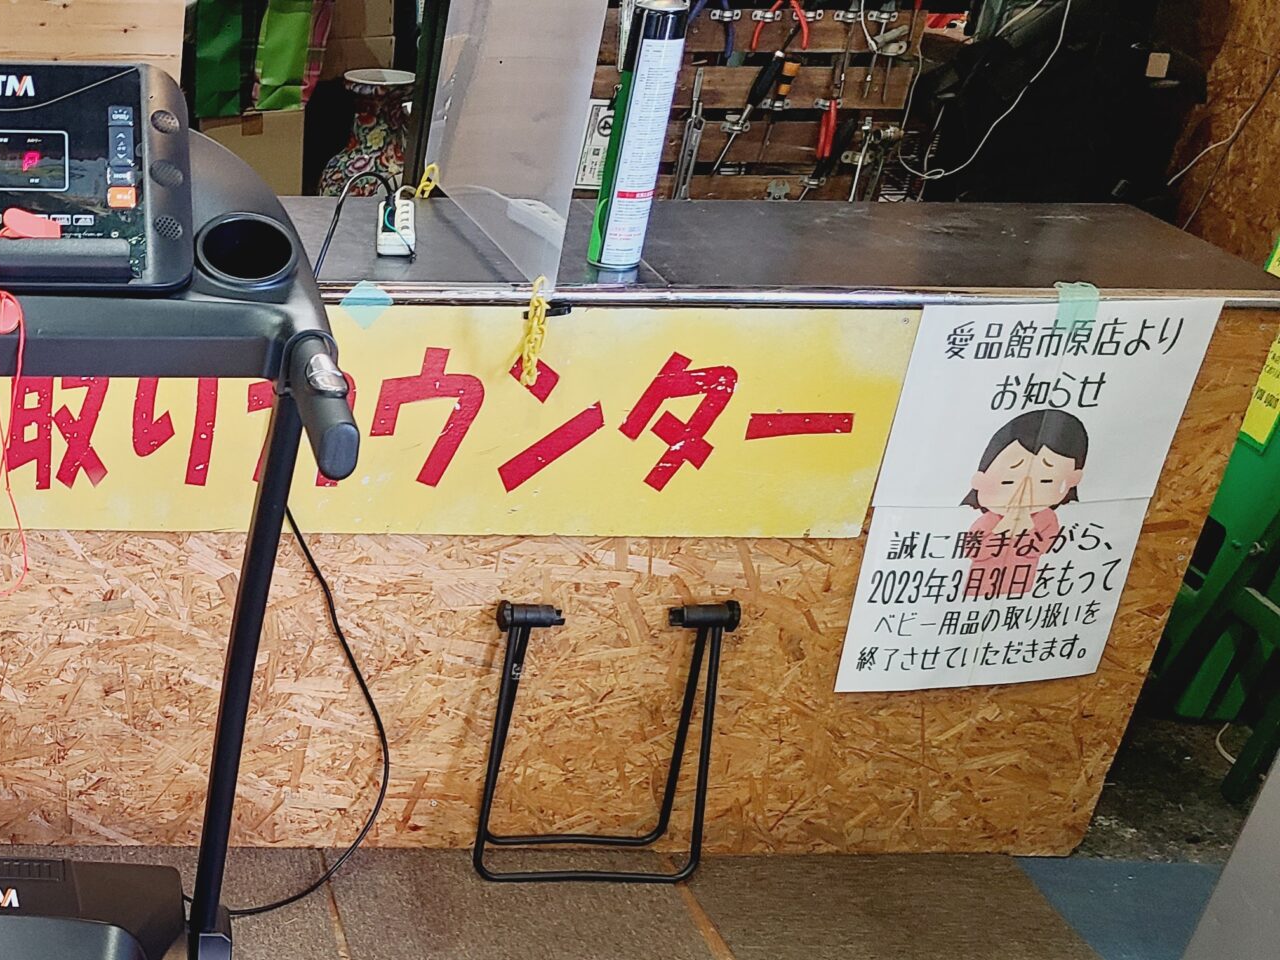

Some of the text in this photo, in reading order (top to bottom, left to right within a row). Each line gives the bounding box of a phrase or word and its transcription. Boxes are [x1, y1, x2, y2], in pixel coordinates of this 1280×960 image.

[944, 317, 1185, 360] 愛品館市原店より
[991, 372, 1106, 411] お知らせ
[887, 523, 1114, 561] 誠に勝手ながら、
[867, 558, 1122, 605] 2023年3月31日をもって
[873, 599, 1101, 637] ベビー用品の取り扱いを
[855, 634, 1088, 673] 終了させていただきます。
